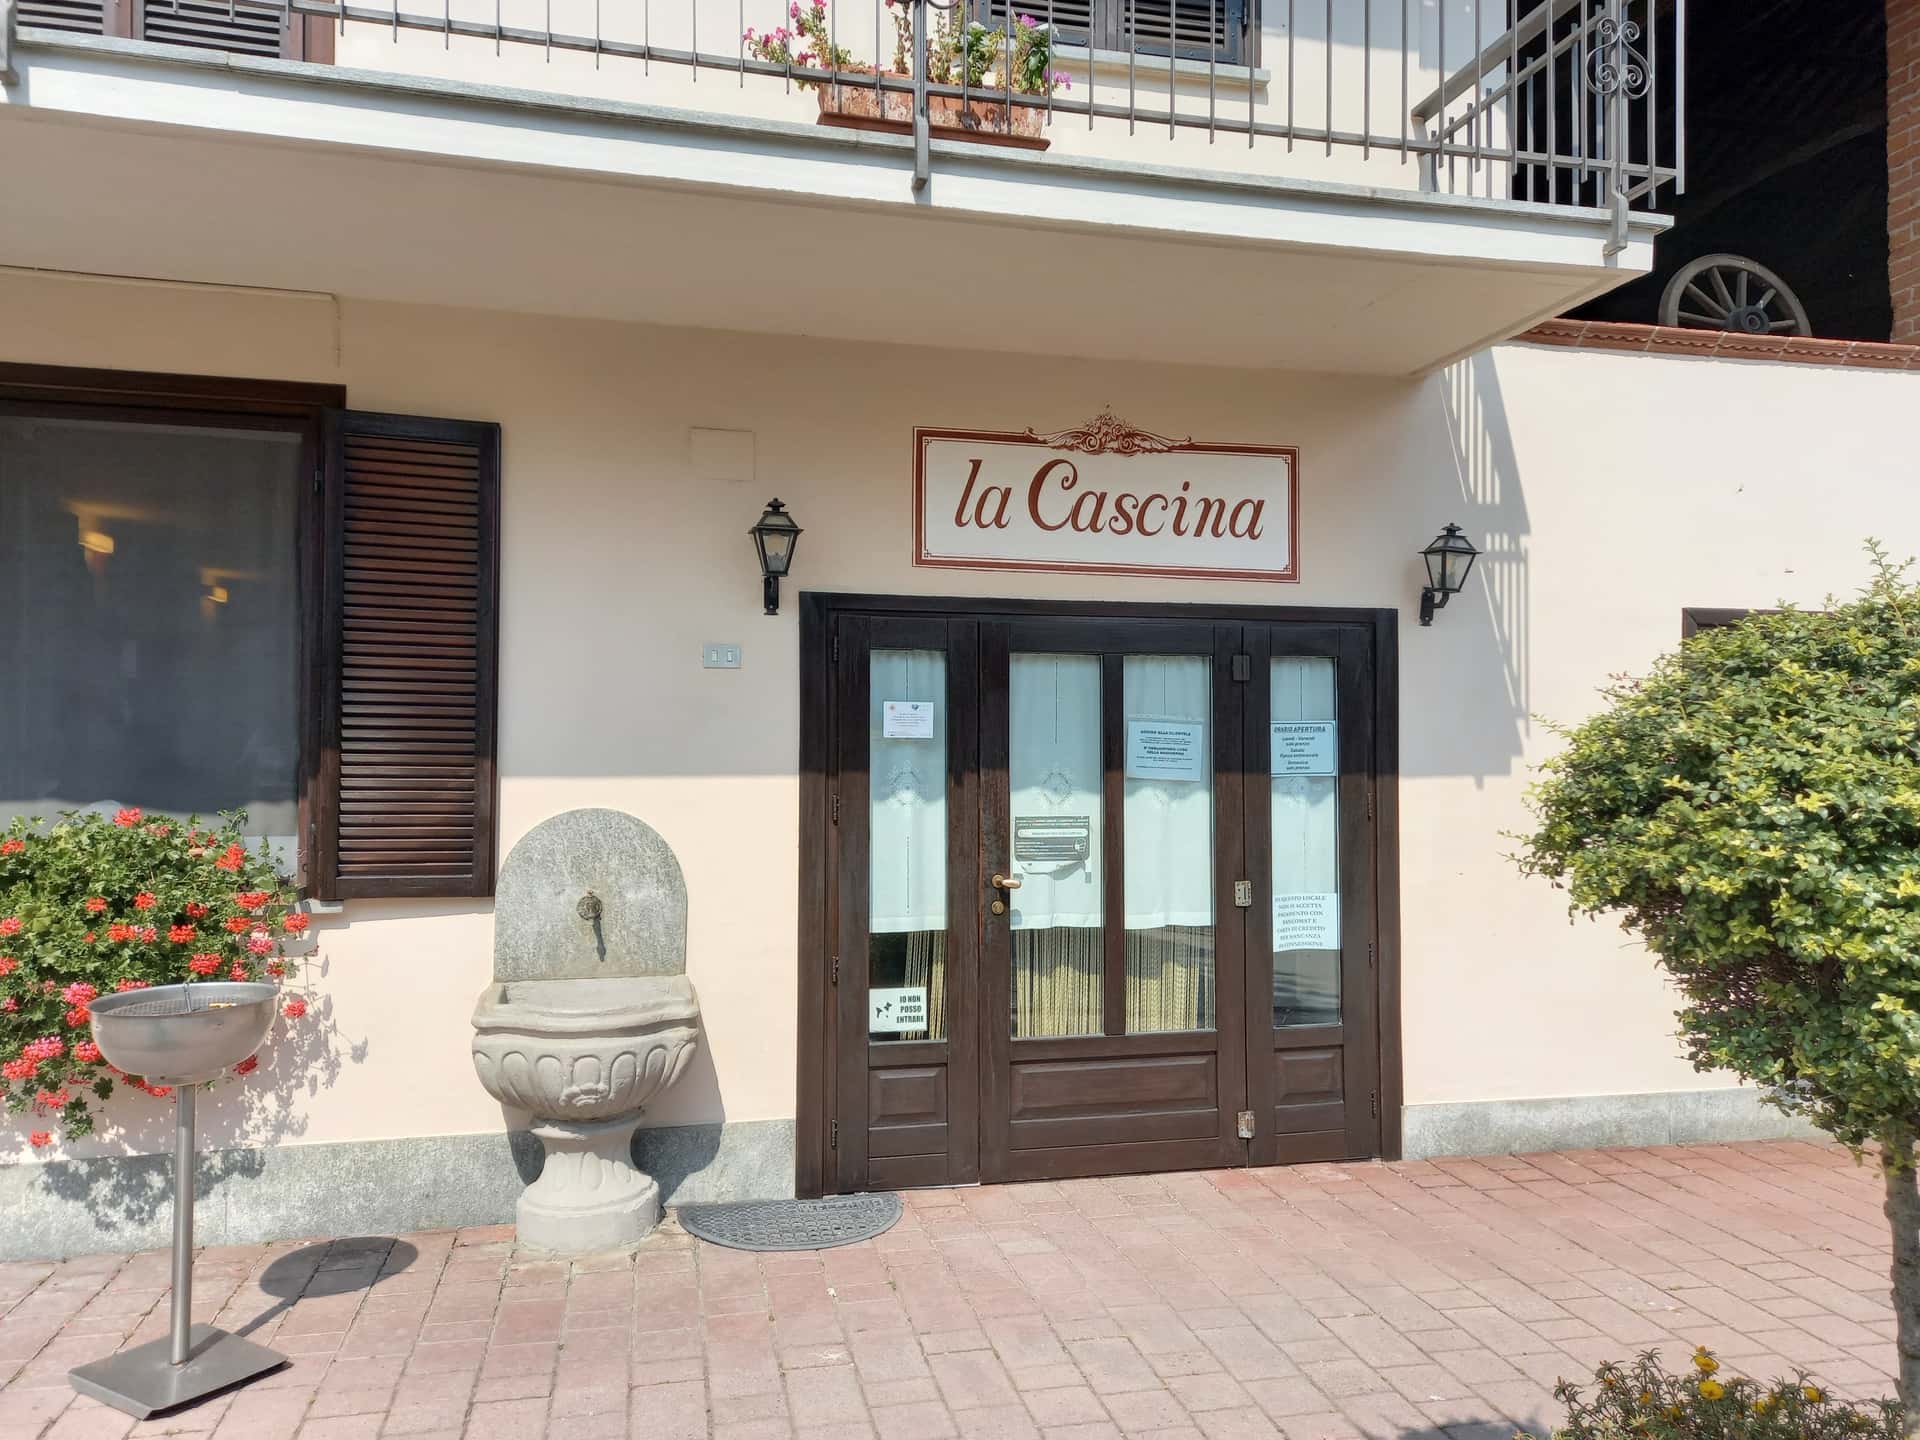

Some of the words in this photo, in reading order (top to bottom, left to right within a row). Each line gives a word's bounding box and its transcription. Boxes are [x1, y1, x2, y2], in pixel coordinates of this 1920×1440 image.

[954, 459, 1012, 529] la
[1028, 458, 1265, 540] Cascina
[899, 995, 906, 1003] IO
[908, 995, 921, 1003] NON
[900, 1005, 922, 1013] POSSO
[896, 1015, 924, 1024] ENTRARE
